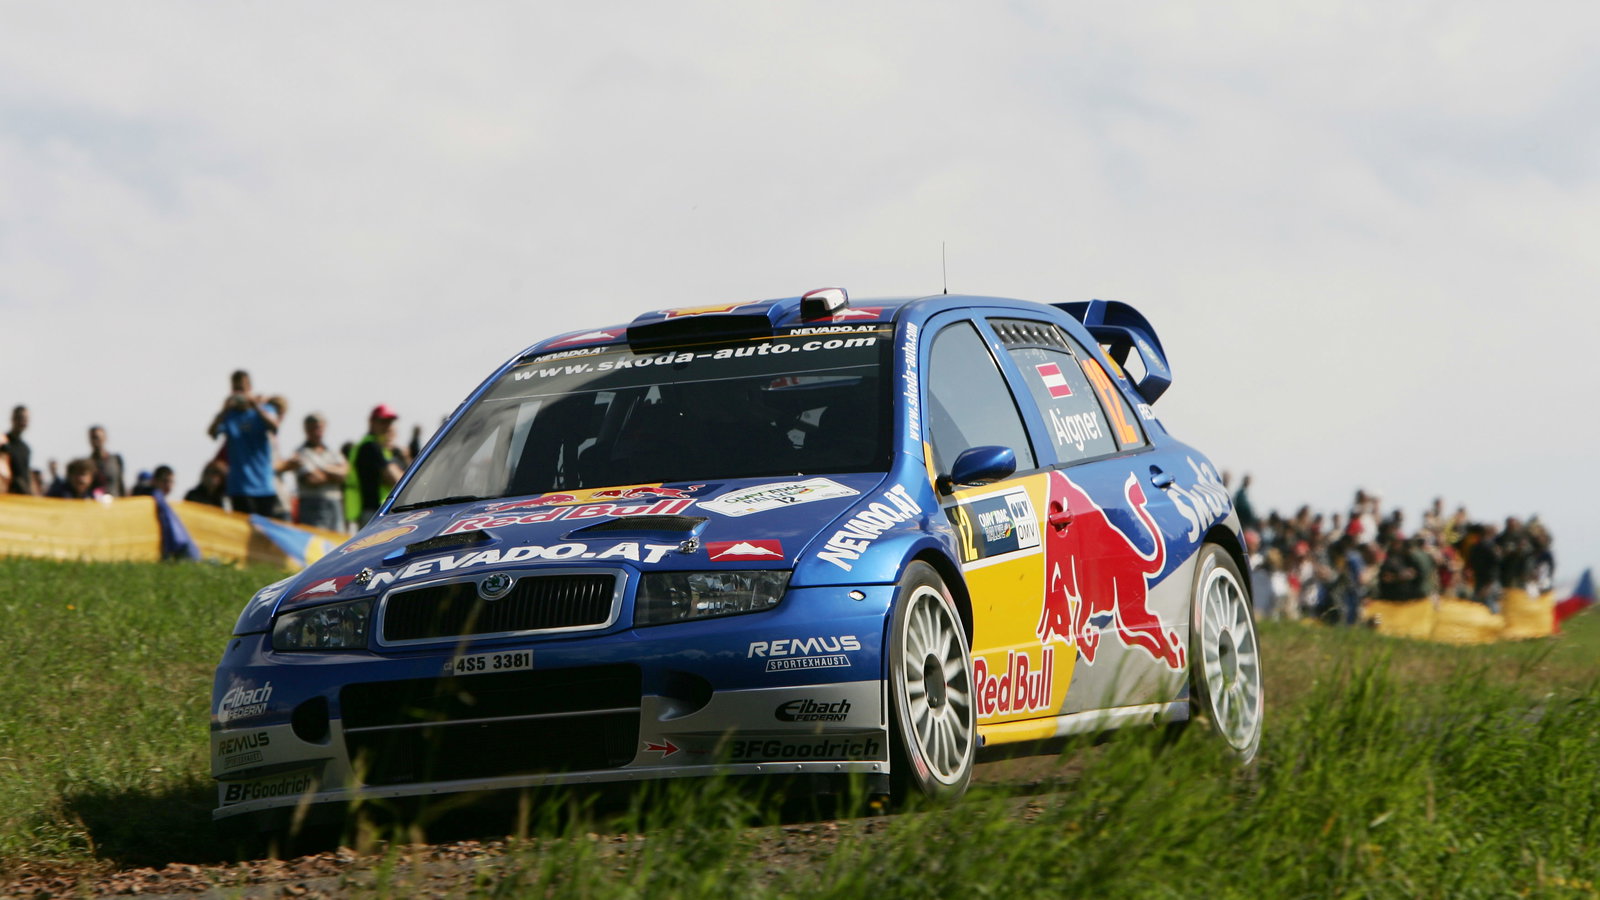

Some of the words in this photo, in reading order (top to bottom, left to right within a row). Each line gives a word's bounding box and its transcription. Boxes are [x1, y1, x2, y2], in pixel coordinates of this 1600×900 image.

[790, 325, 876, 336] NEVADO.AT
[514, 337, 877, 381] www.skoda-auto.com
[534, 346, 609, 363] NEVADO.AT
[902, 322, 920, 442] www.skoda-auto.com
[1082, 358, 1139, 444] 12
[1049, 407, 1102, 452] Aigner
[775, 496, 802, 504] 12
[440, 507, 569, 535] Red
[561, 499, 697, 521] Bull
[817, 483, 922, 572] NEVADO.AT
[1018, 523, 1035, 540] OMV
[367, 541, 677, 590] NEVADO.AT
[747, 635, 861, 658] REMUS
[456, 656, 486, 672] 4S5
[493, 653, 529, 670] 3381
[770, 656, 844, 670] SPORTEXHAUST
[973, 649, 1015, 718] Red
[1012, 645, 1054, 713] Bull
[218, 681, 273, 723] Eibach
[775, 699, 851, 722] Eibach
[218, 732, 270, 756] REMUS
[731, 738, 880, 758] BFGoodrich
[224, 775, 310, 802] BFGoodrich
